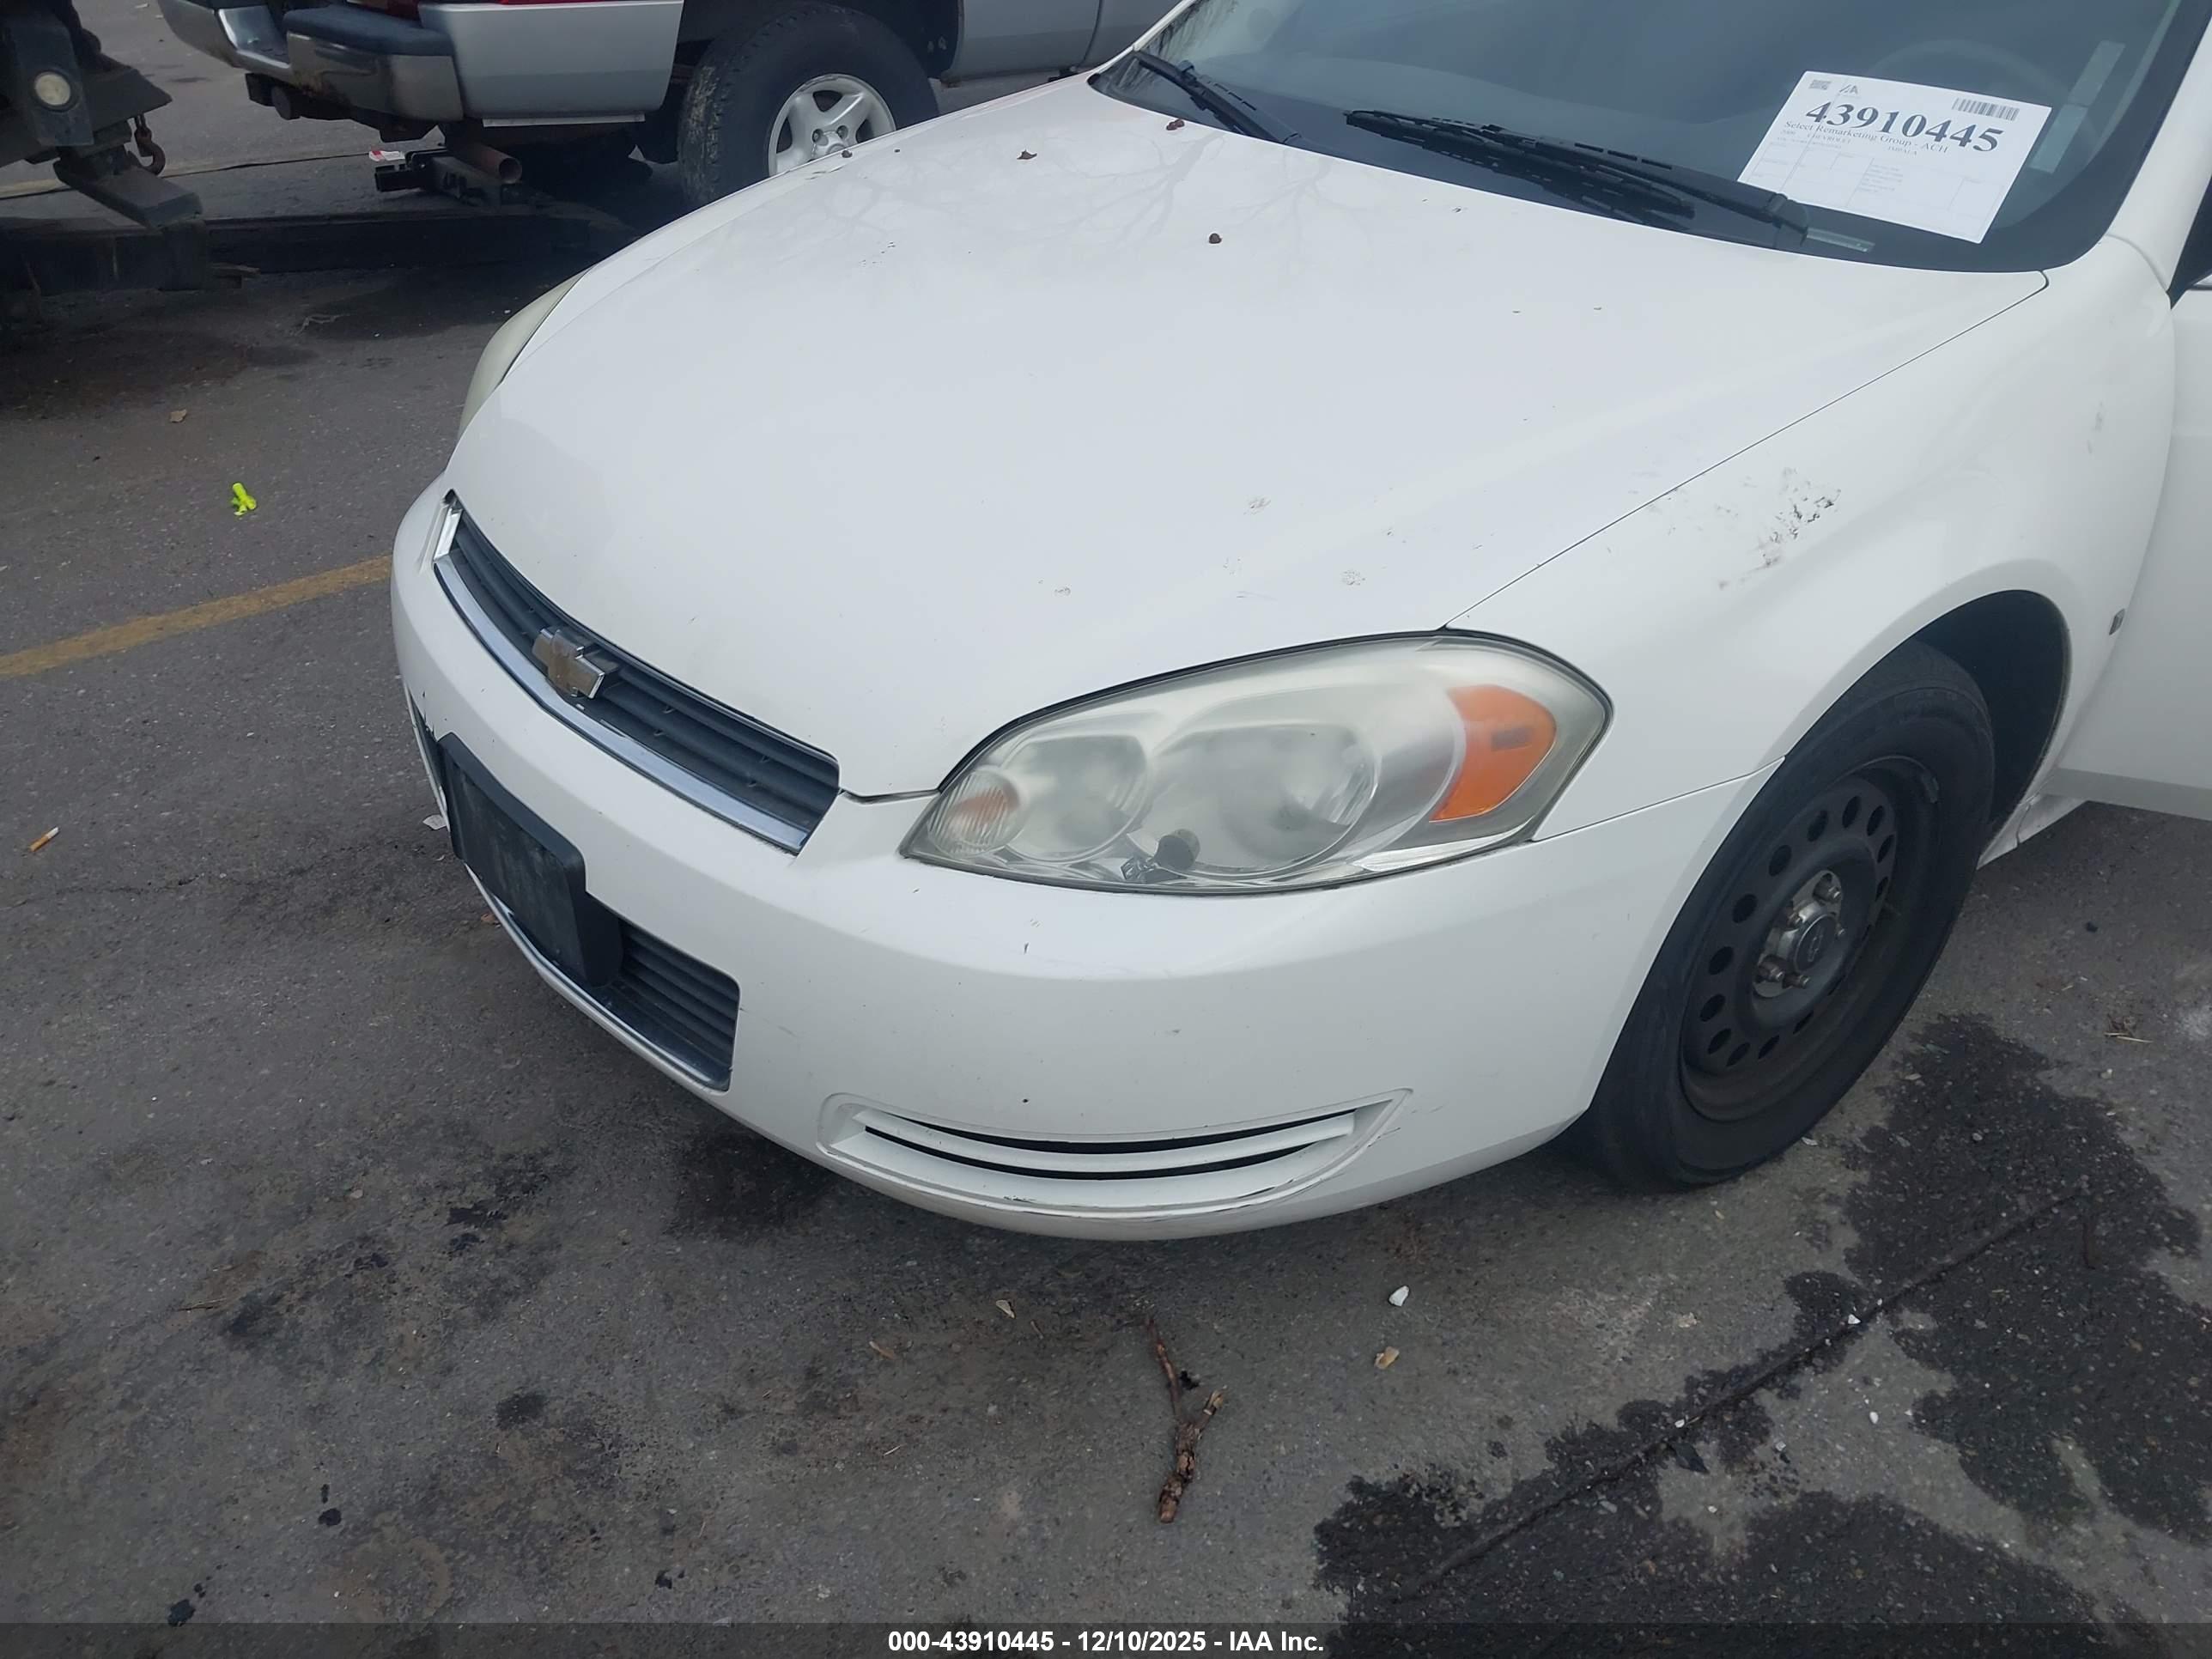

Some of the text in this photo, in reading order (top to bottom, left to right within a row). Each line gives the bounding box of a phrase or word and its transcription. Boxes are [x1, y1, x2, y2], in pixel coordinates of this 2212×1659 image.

[1784, 121, 1814, 131] Select
[1816, 124, 1877, 142] Remarketing
[1880, 135, 1911, 148] Group
[1805, 100, 2004, 152] 43910445
